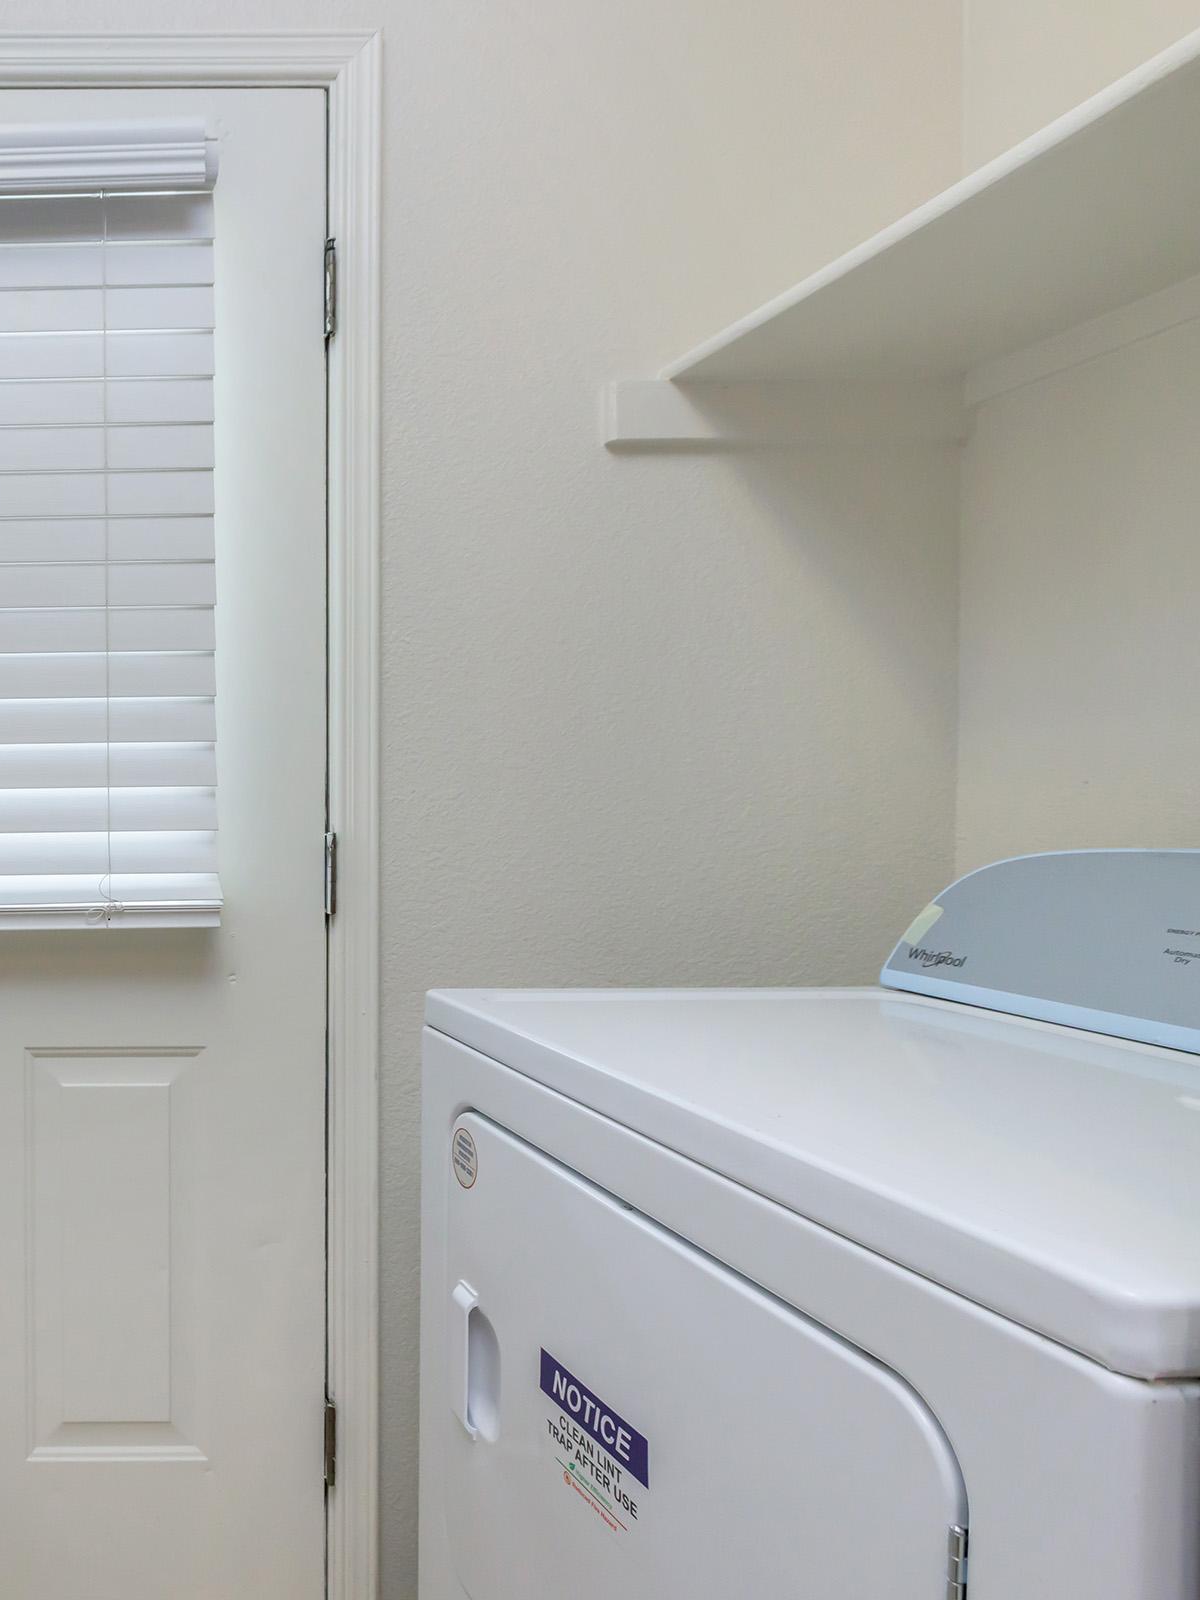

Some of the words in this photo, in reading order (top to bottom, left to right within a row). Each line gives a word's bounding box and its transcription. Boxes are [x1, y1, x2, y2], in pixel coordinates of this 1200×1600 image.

[908, 947, 968, 968] Whirlpool
[1174, 956, 1191, 966] Dry
[552, 1369, 632, 1462] NOTICE
[559, 1415, 594, 1458] CLEAN
[597, 1450, 622, 1483] LINT
[546, 1418, 573, 1452] TRAP
[575, 1449, 611, 1493] AFTER
[613, 1485, 638, 1521] USE
